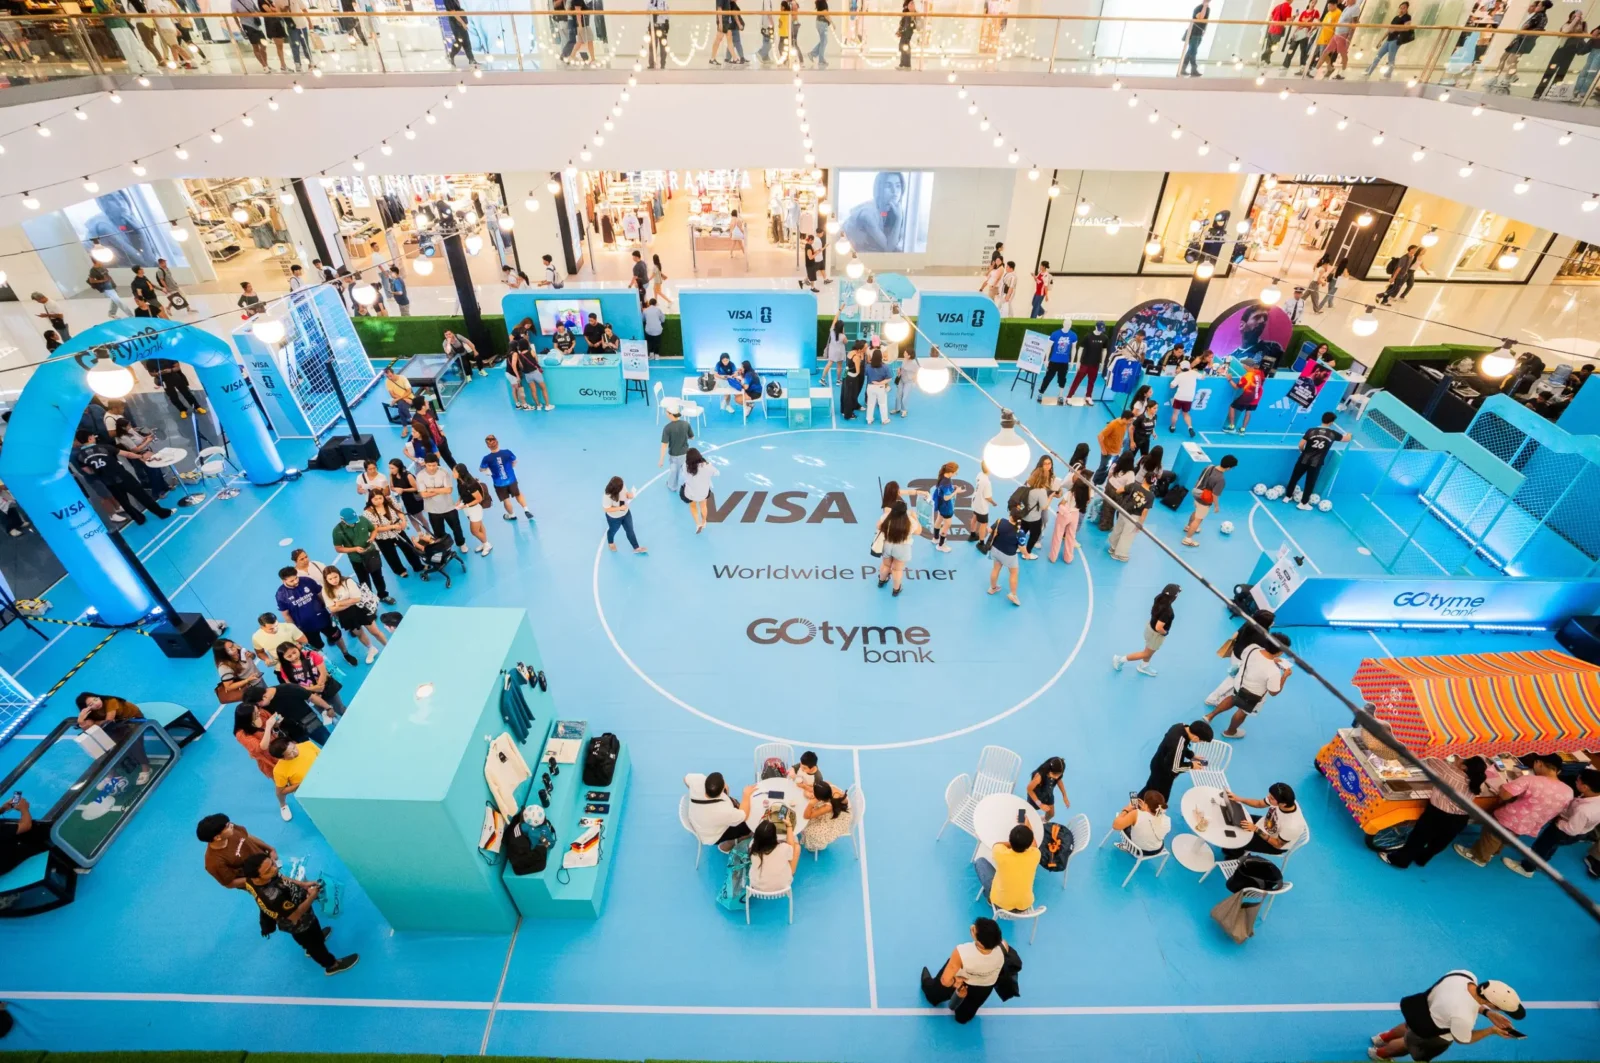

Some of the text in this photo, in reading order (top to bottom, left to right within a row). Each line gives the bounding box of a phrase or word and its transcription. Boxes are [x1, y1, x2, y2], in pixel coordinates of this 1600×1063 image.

[726, 309, 753, 320] VISA
[936, 312, 964, 323] VISA
[252, 361, 270, 369] VISA
[221, 379, 244, 394] VISA
[578, 387, 618, 398] GOtyme
[1311, 439, 1326, 450] 26
[89, 457, 107, 470] 26
[50, 500, 85, 520] VISA
[705, 490, 859, 524] VISA
[712, 564, 958, 581] Worldwide Ptner
[1393, 591, 1485, 610] GOtyme
[1440, 607, 1478, 617] bank
[746, 617, 931, 651] GOtyme
[863, 646, 935, 663] bank
